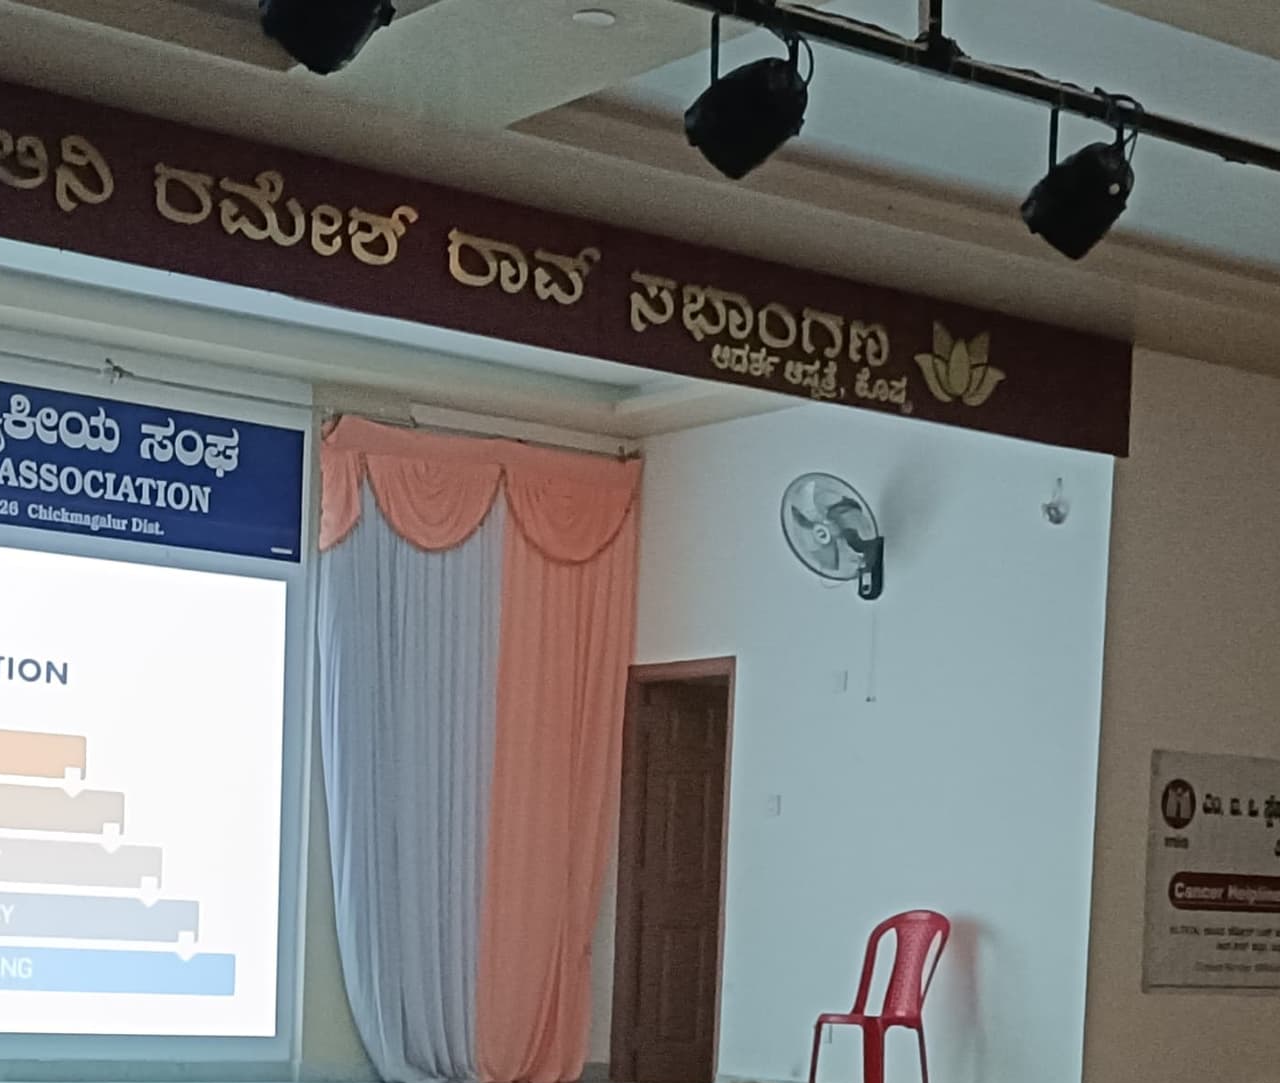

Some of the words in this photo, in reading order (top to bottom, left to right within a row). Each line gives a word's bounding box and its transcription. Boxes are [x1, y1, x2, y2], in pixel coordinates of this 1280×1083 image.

[154, 162, 418, 266] ರಮೇಶ್
[447, 227, 601, 305] ರಾವ್
[628, 270, 890, 368] ಸಭಾಂಗಣ
[139, 416, 239, 478] ಸಂಘ
[27, 501, 128, 531] Chickmagalur
[131, 515, 164, 536] Dist.
